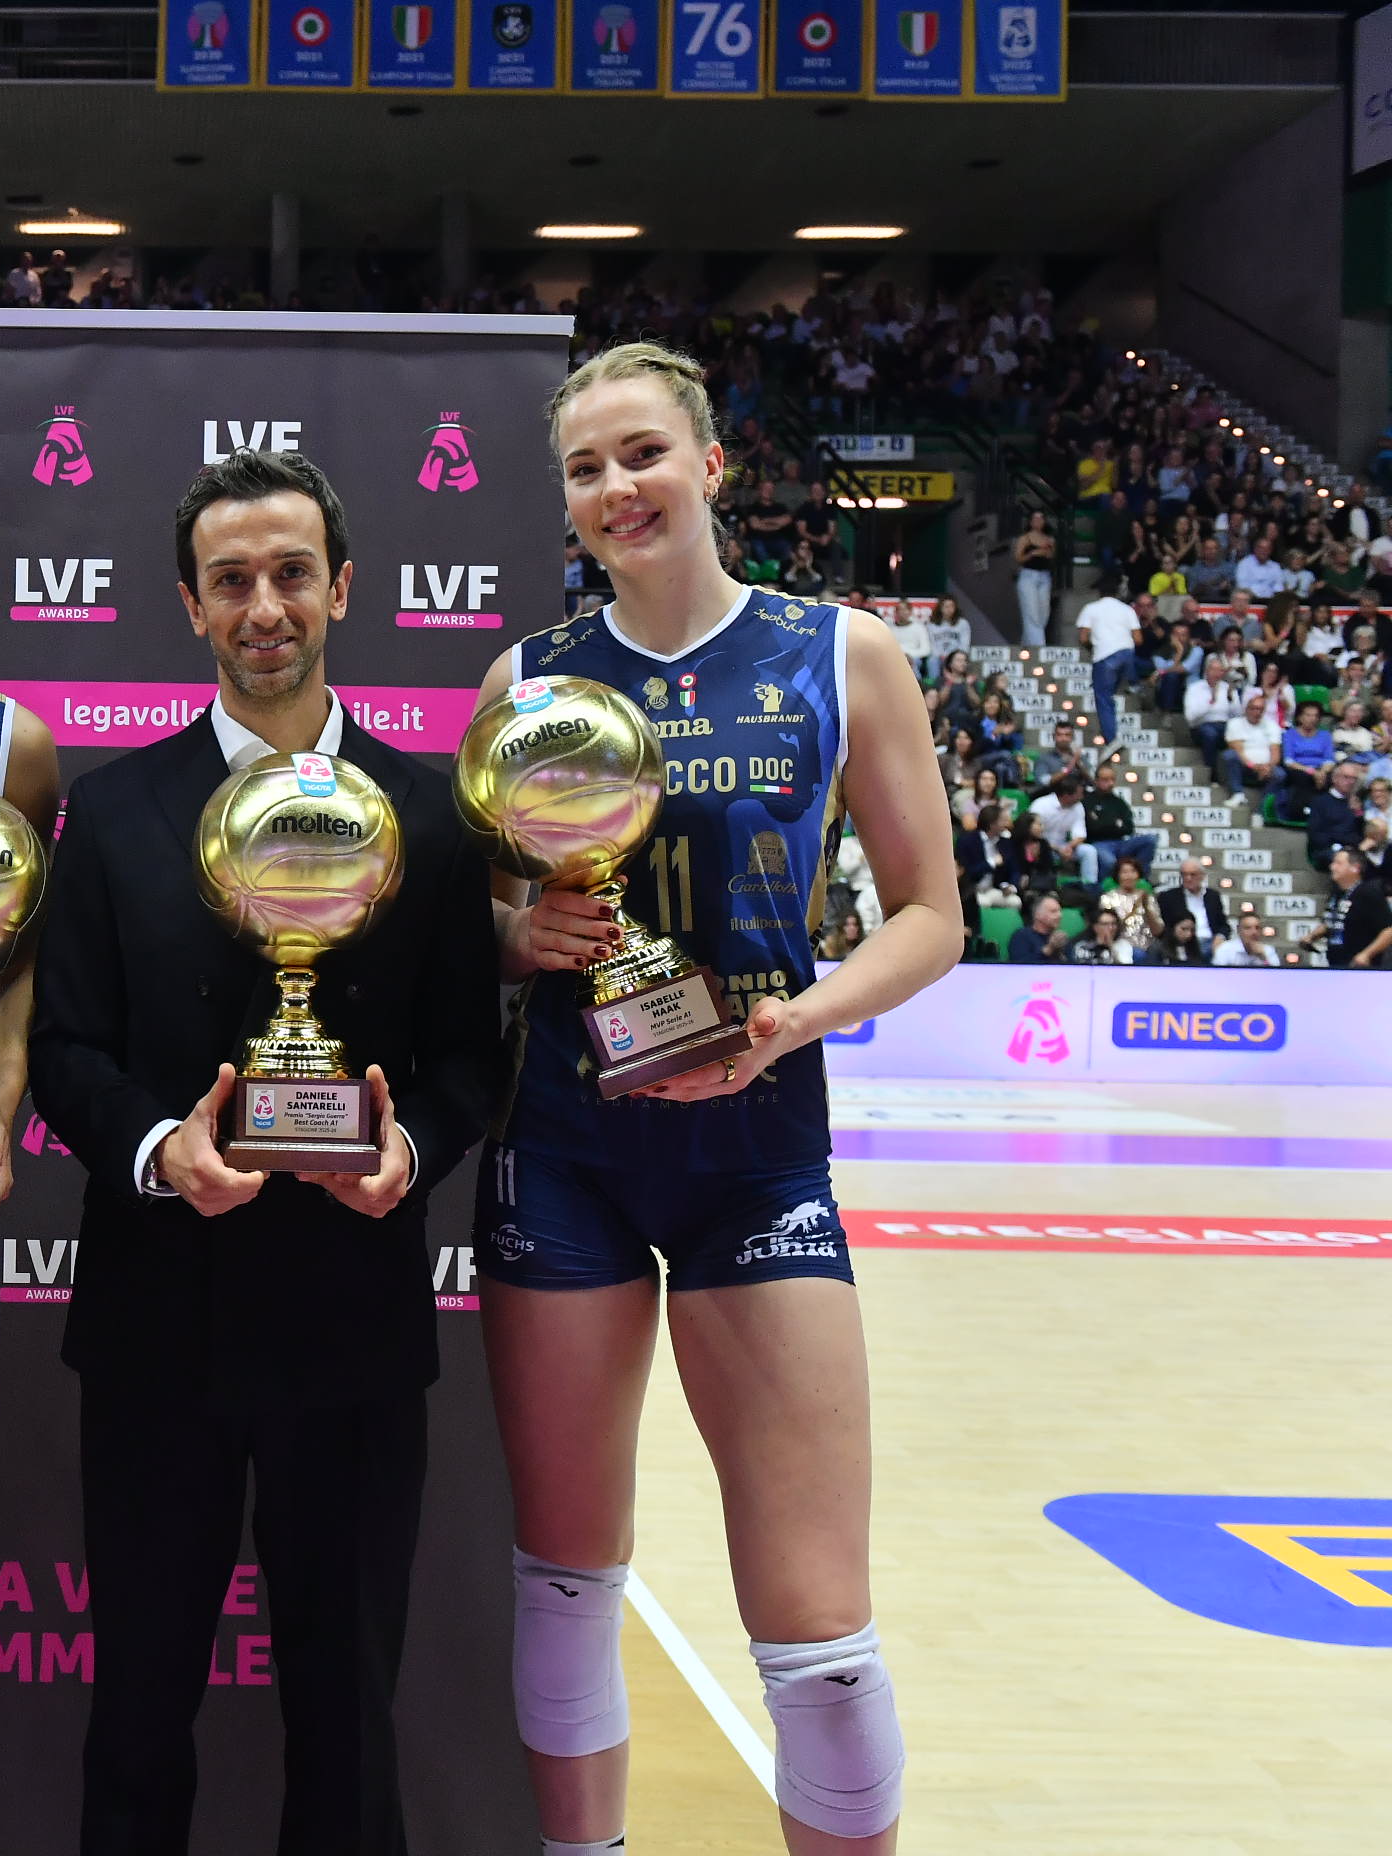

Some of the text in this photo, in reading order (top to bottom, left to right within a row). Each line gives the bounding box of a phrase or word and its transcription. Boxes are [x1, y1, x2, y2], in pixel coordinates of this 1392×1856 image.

[685, 2, 753, 58] 76
[55, 406, 74, 415] LVF
[441, 412, 460, 421] LVF
[15, 558, 113, 604] LVF
[400, 565, 499, 610] LVF
[38, 608, 90, 619] AWARDS
[423, 615, 475, 626] AWARDS
[736, 713, 806, 725] HAUSBRANDT
[501, 718, 592, 760] molten
[749, 757, 794, 782] DOC
[1191, 811, 1222, 820] ITLAS
[272, 812, 362, 839] molten
[1212, 832, 1243, 841] ITLAS
[1231, 854, 1262, 863] ITLAS
[649, 836, 693, 932] 11
[1251, 878, 1284, 888] ITLAS
[1273, 899, 1307, 909] ITLAS
[640, 989, 686, 1012] ISABELLE
[652, 1002, 682, 1019] HAAK
[650, 1021, 665, 1031] MVP
[666, 1014, 683, 1025] Serie
[1127, 1011, 1274, 1043] FINECO
[296, 1091, 338, 1101] DANIELE
[287, 1101, 346, 1111] SANTARELLI
[309, 1119, 329, 1127] Coach
[496, 1146, 516, 1206] 11
[491, 1231, 536, 1252] FUCHS
[26, 1290, 73, 1300] AWARD
